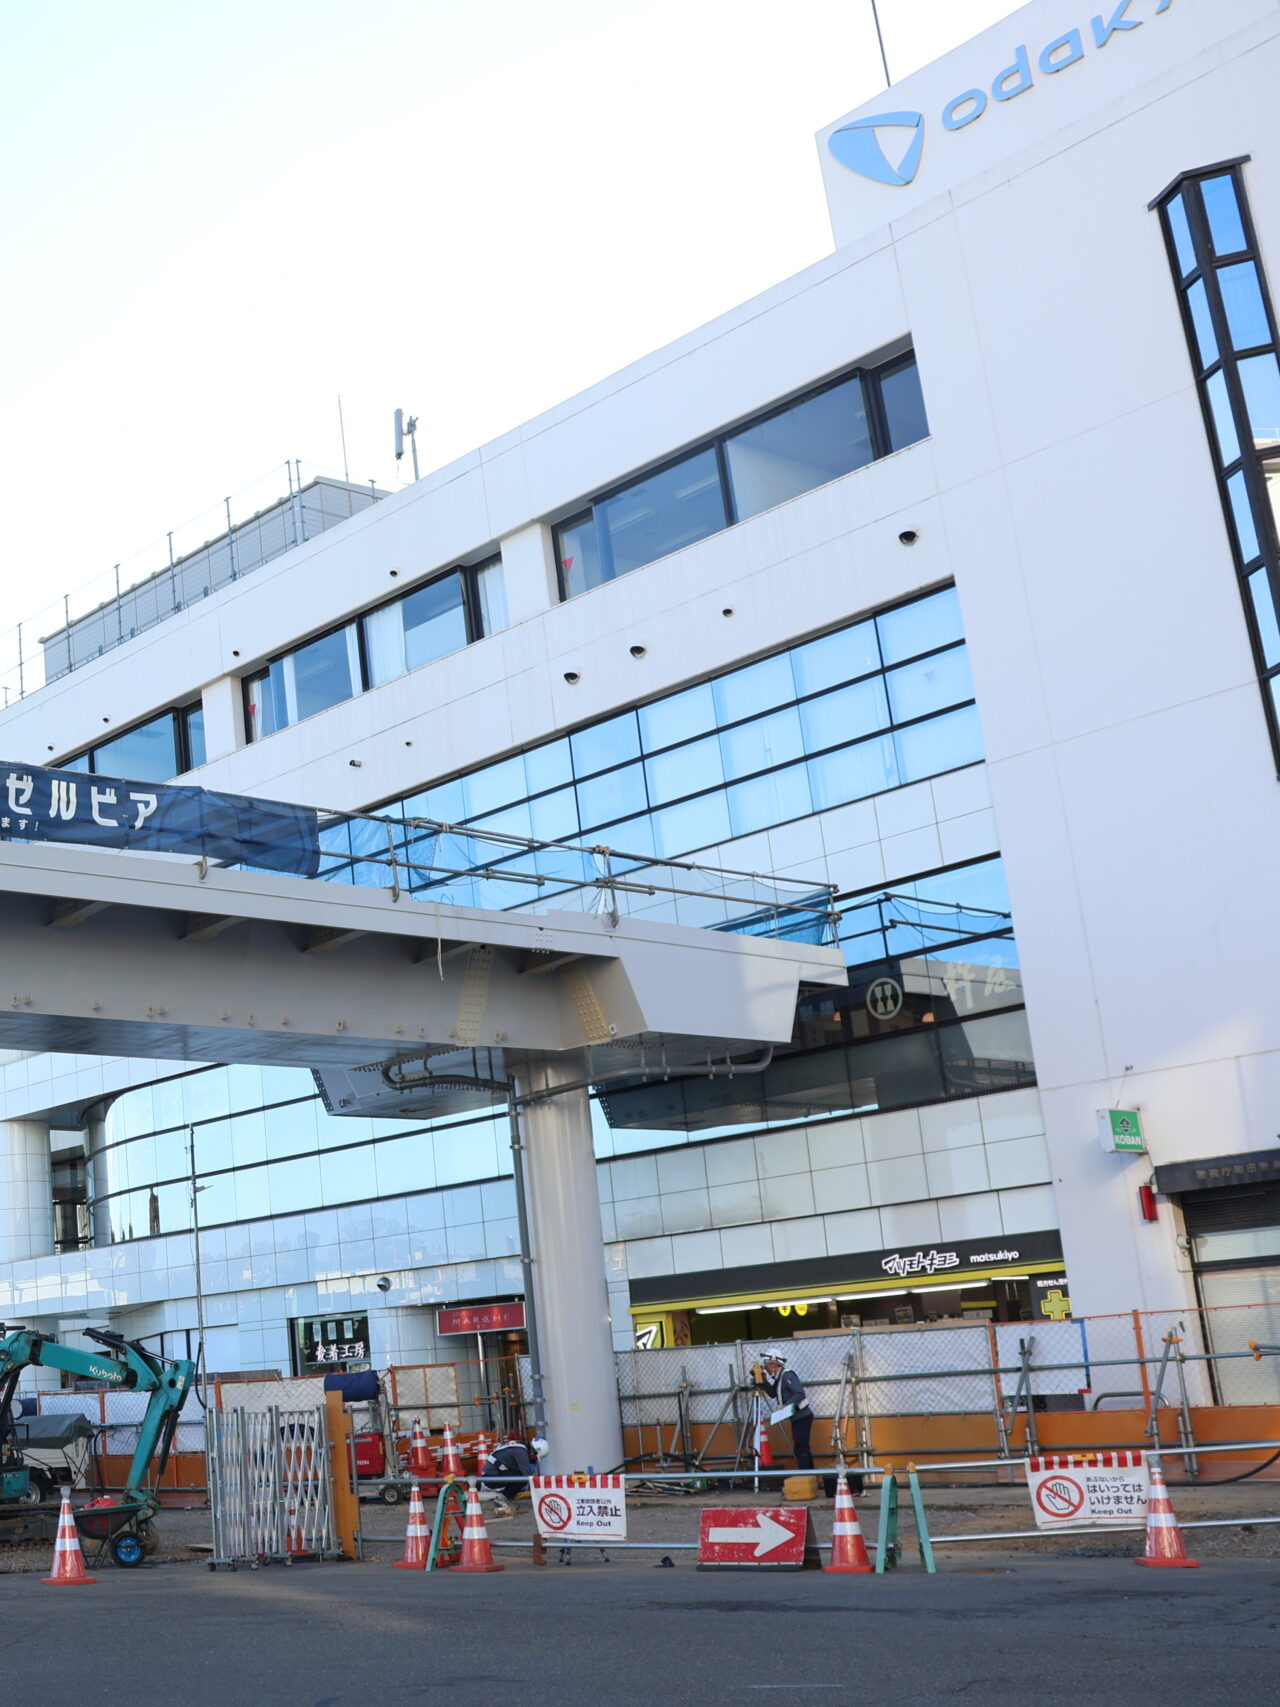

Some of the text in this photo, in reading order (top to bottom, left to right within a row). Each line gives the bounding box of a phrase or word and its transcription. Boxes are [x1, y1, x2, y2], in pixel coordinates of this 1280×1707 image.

[941, 0, 1174, 131] odak
[1114, 1134, 1142, 1146] KOBAN
[969, 1250, 1020, 1264] matsukiyo
[881, 1250, 960, 1277] マツモトキヨシ
[89, 1365, 123, 1383] Kubota
[1087, 1483, 1144, 1494] はいっては
[1088, 1495, 1148, 1506] いけません
[576, 1505, 622, 1517] 立入禁止
[1090, 1508, 1114, 1516] Keep
